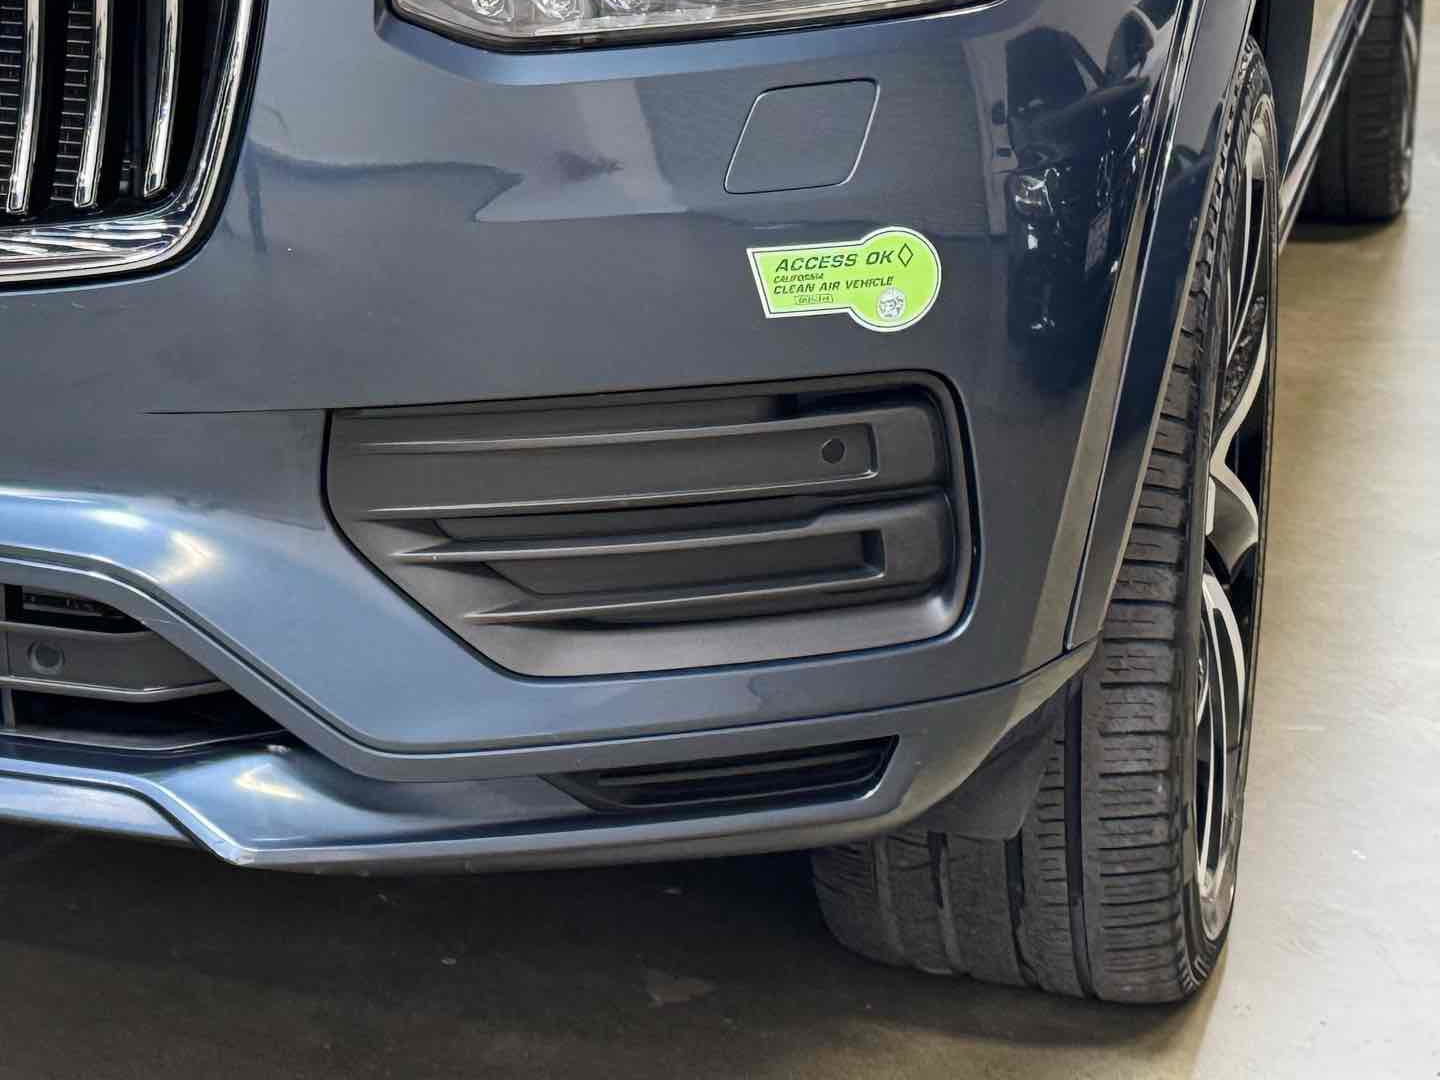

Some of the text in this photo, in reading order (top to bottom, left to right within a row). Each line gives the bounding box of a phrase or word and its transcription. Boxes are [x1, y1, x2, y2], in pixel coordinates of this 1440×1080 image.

[775, 249, 895, 273] ACCESS OK
[773, 275, 894, 295] CLEAN AIR VEHICLE
